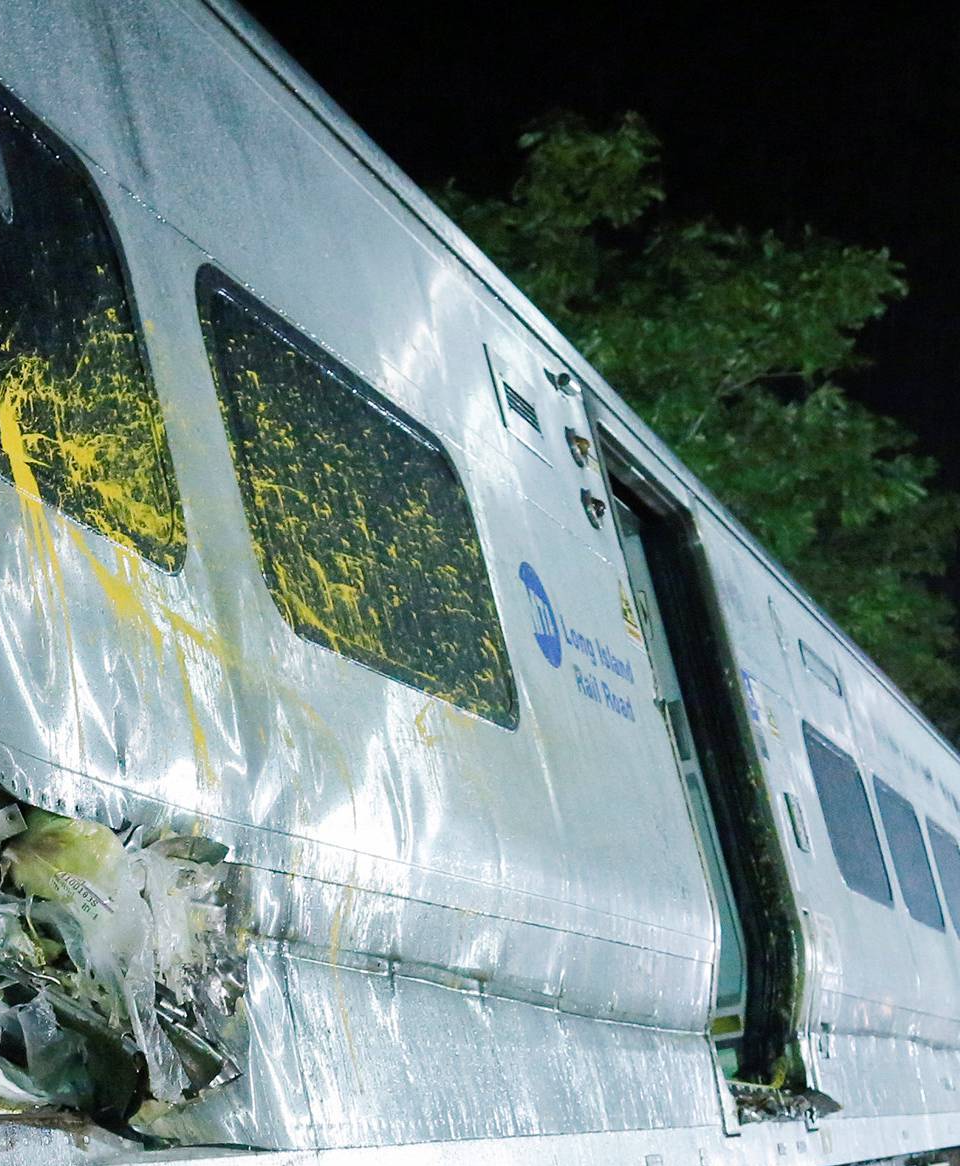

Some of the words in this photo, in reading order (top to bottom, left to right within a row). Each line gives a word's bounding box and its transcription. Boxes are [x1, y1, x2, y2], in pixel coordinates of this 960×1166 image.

[560, 614, 597, 667] Long
[595, 638, 634, 684] Island
[573, 664, 602, 704] Rail
[601, 680, 635, 722] Road
